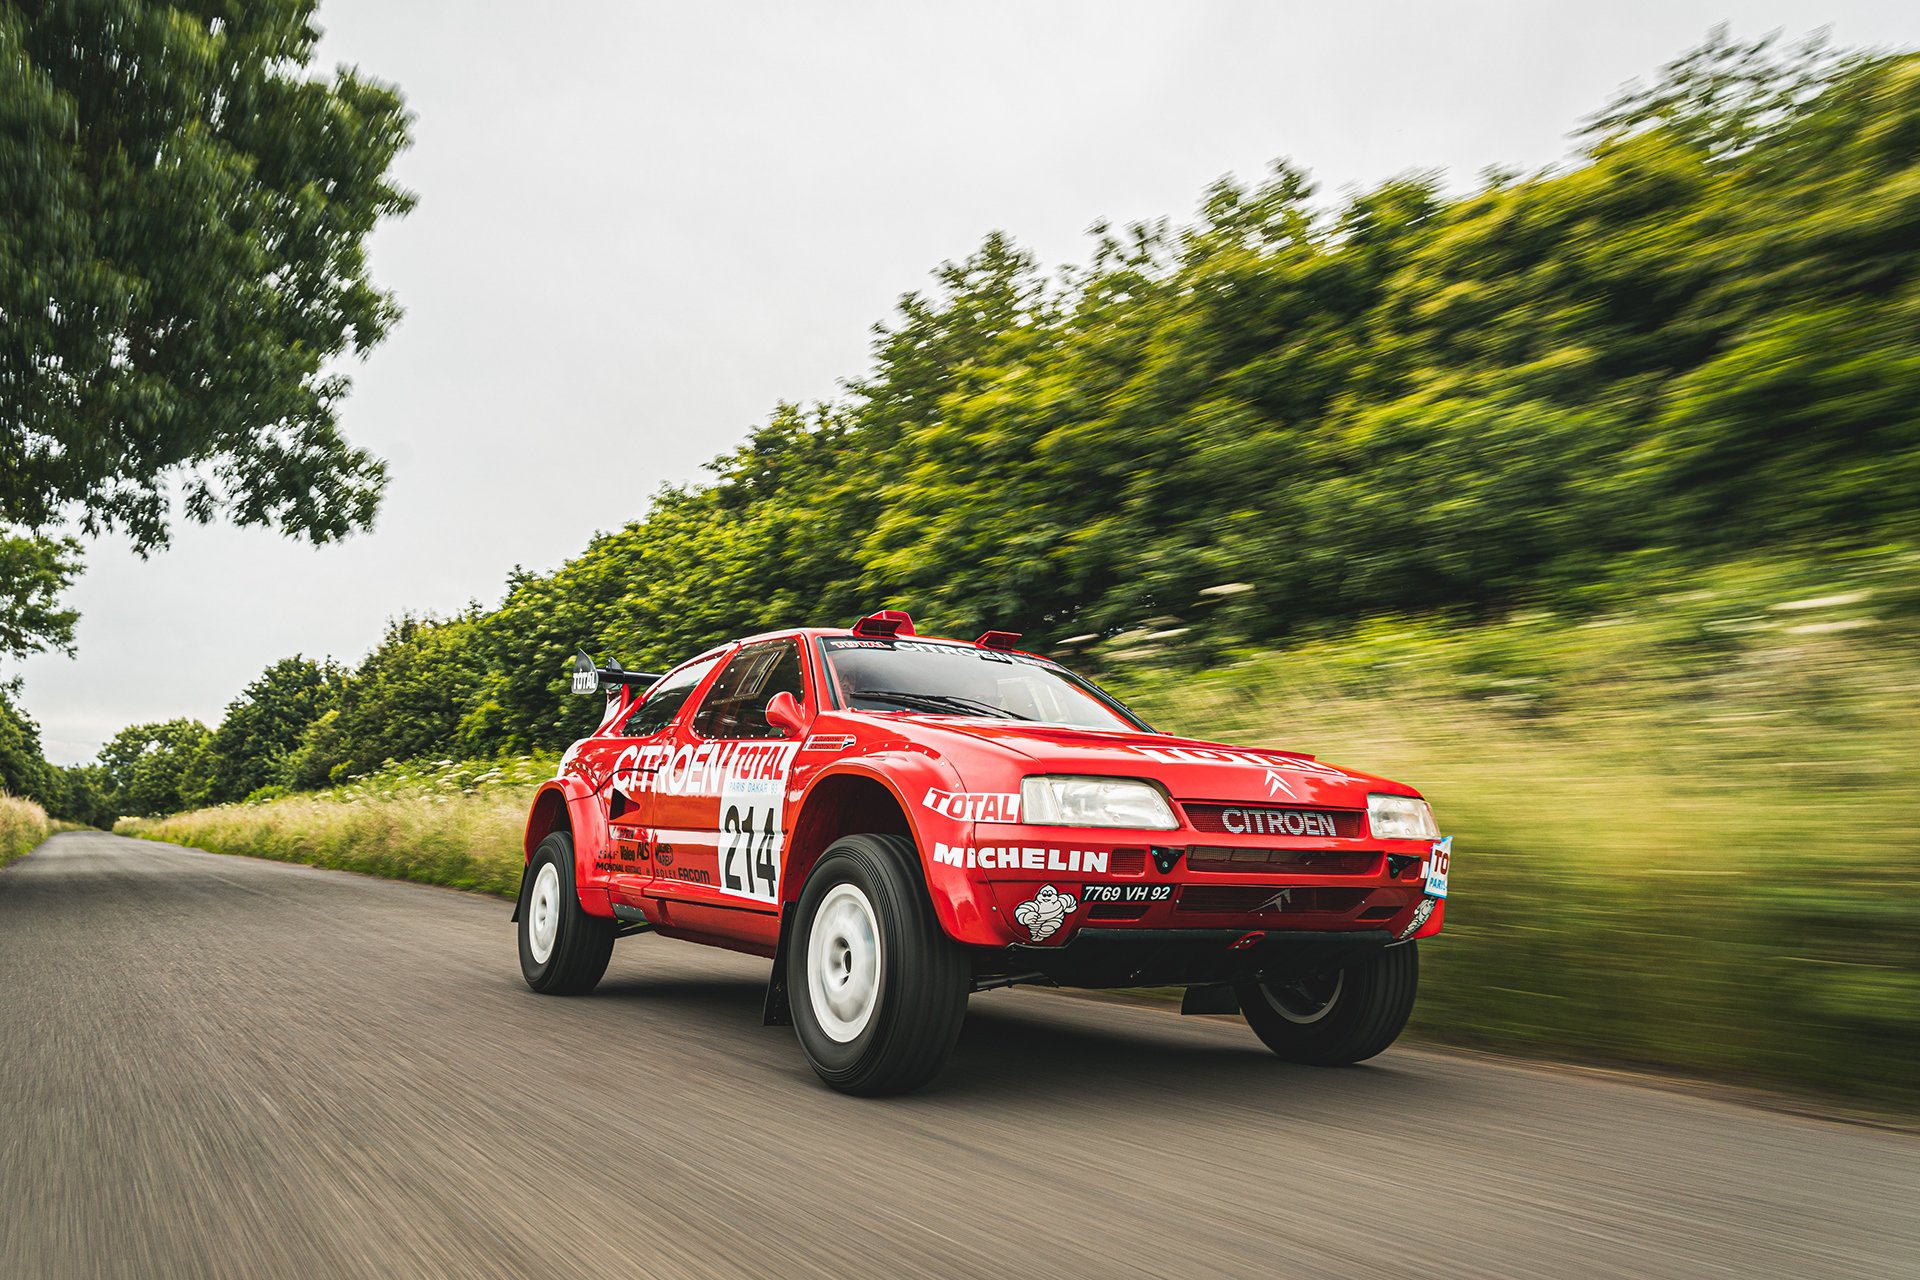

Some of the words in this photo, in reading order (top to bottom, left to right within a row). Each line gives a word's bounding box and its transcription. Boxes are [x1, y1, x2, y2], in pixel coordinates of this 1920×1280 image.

[830, 641, 892, 649] TOTAL
[573, 671, 596, 690] TOTAL
[612, 739, 734, 794] CITROËN
[732, 746, 789, 780] TOTAL
[729, 782, 746, 793] PARIS
[747, 782, 768, 793] DAKAR
[931, 789, 1015, 821] TOTAL
[1221, 808, 1337, 836] CITROEN
[620, 845, 636, 862] Valeo
[724, 805, 777, 897] 214
[933, 842, 1109, 873] MICHELIN
[595, 862, 625, 873] MONDIAL
[656, 868, 676, 878] SOLEX
[1084, 886, 1121, 901] 7769
[1126, 886, 1149, 901] VH
[1150, 886, 1171, 900] 92
